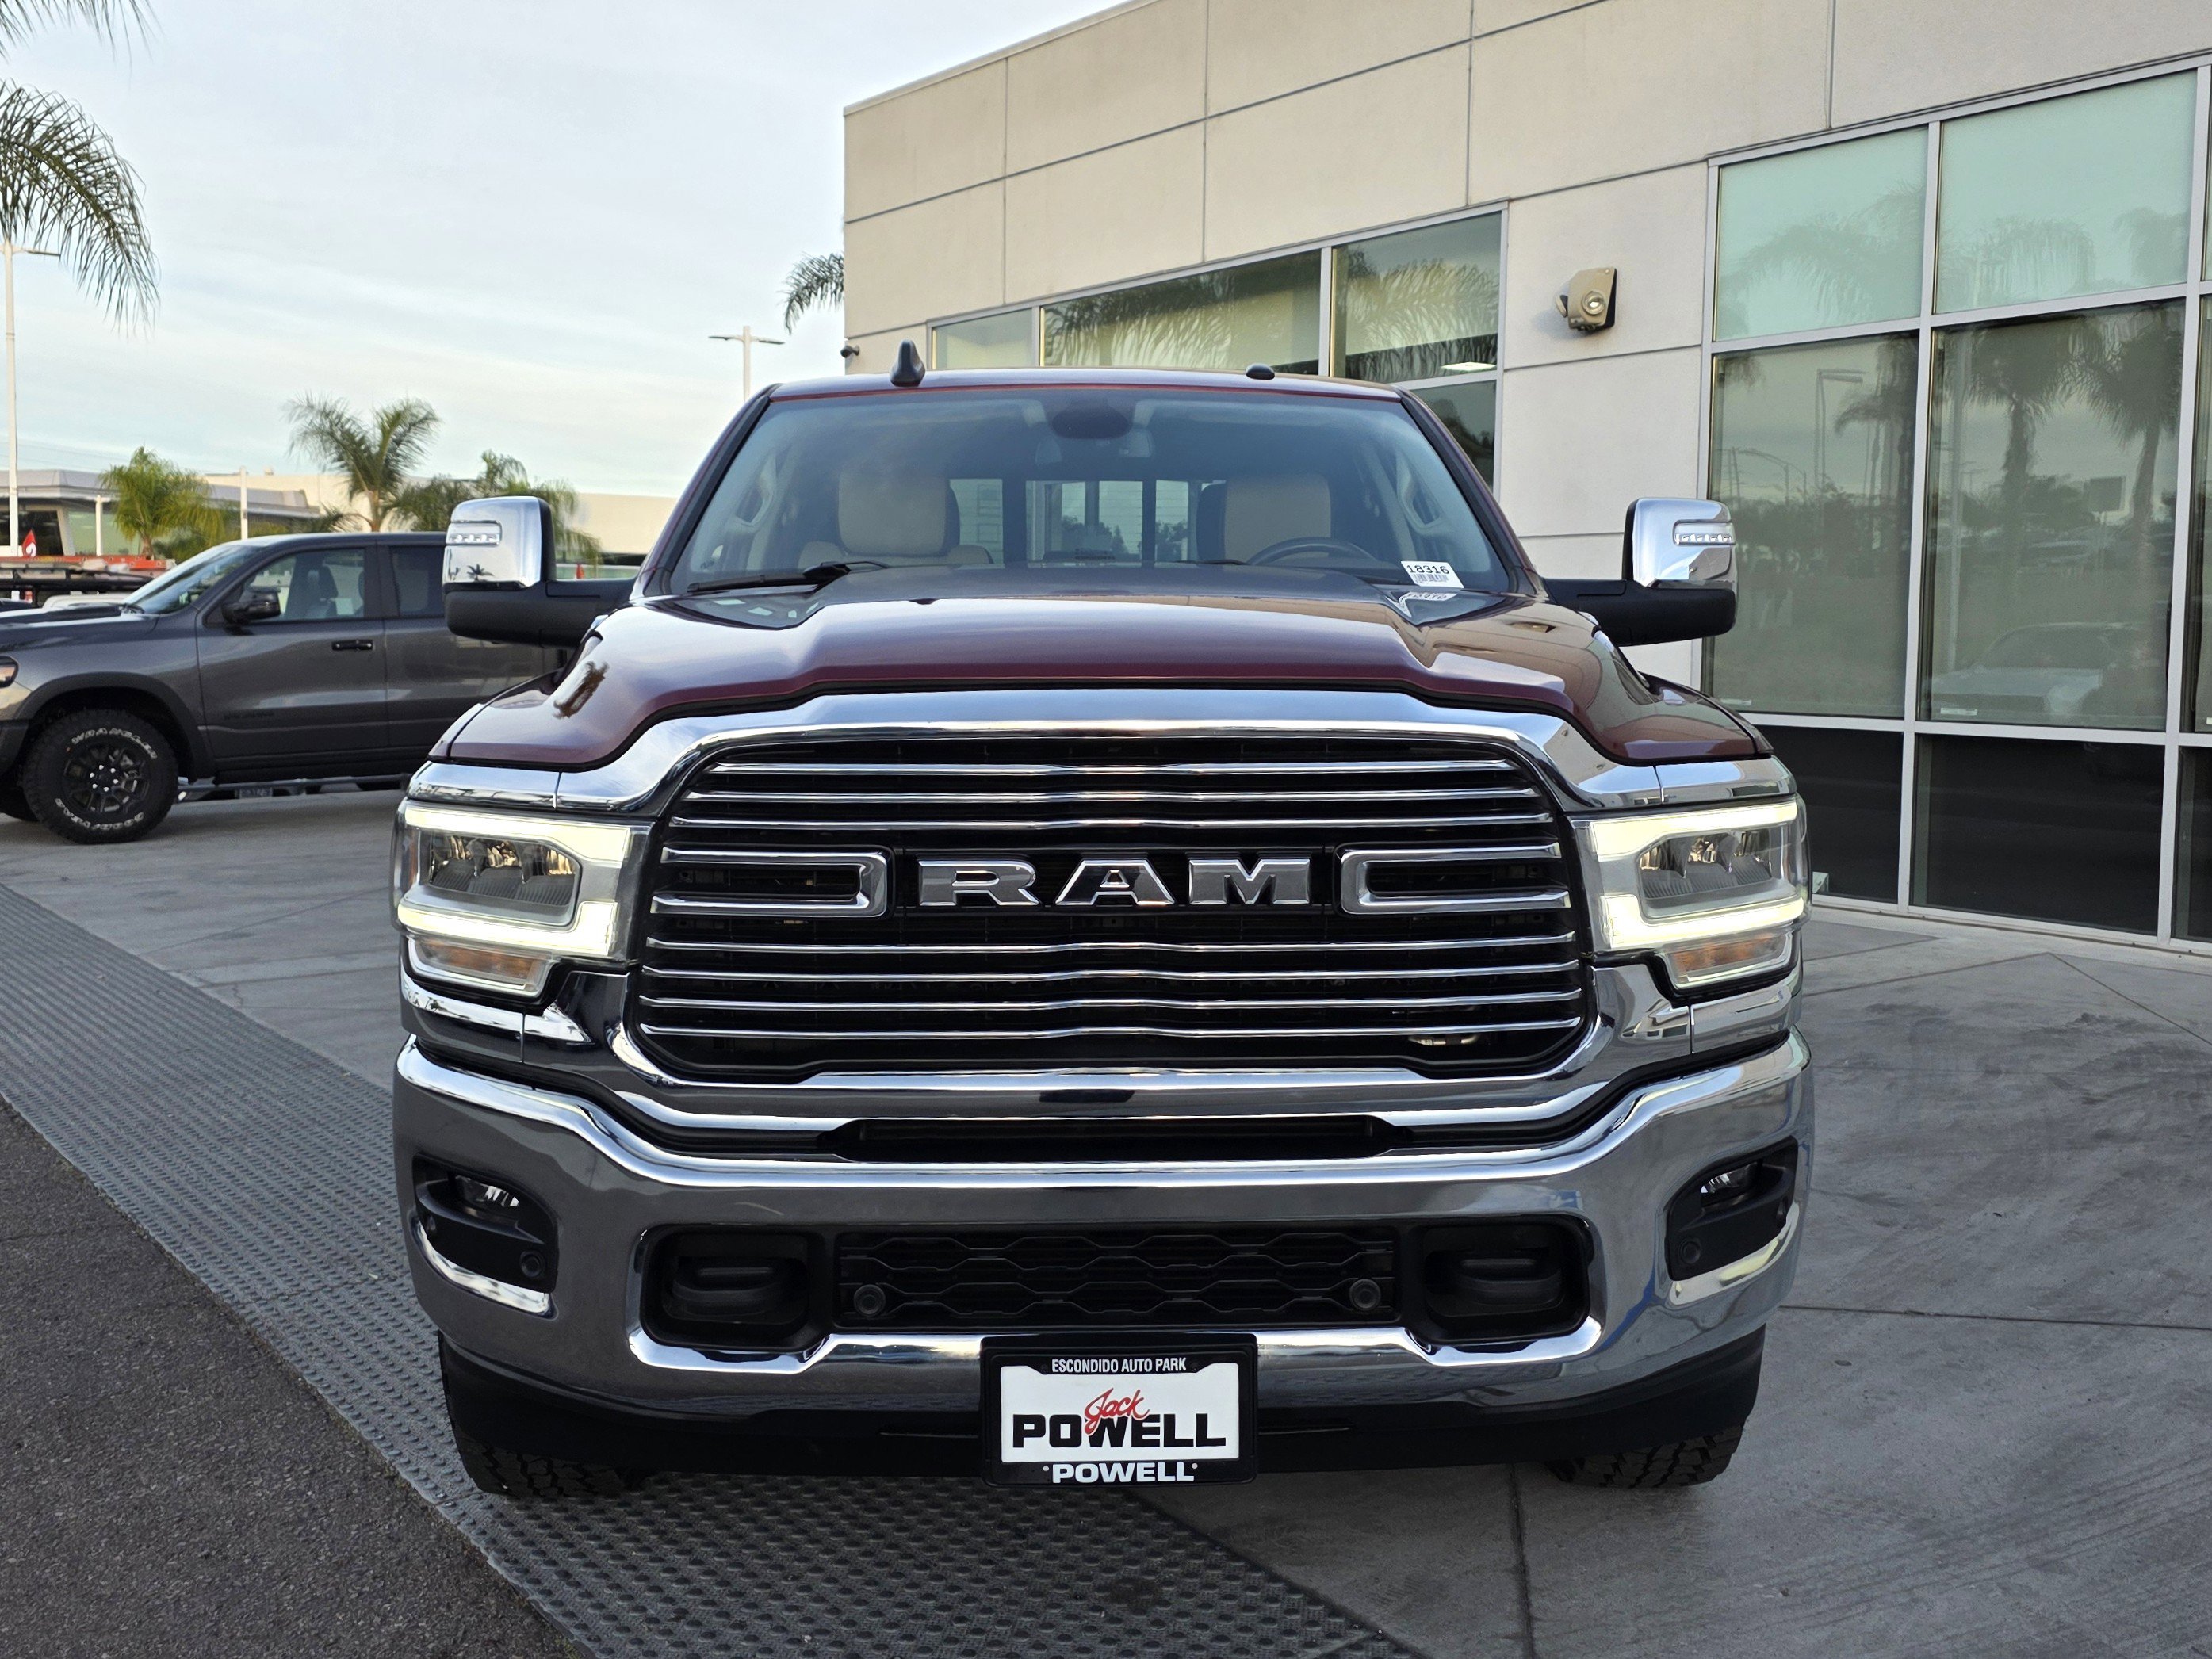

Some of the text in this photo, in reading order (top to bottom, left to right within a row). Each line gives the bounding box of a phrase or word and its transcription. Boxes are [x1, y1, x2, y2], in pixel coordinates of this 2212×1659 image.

[1406, 564, 1450, 575] 18316
[918, 858, 1311, 906] RAM
[1051, 1357, 1187, 1374] ESCONDIDO AUTO PARK
[1084, 1387, 1150, 1436] Jack
[1012, 1413, 1227, 1448] POWELL
[1051, 1462, 1195, 1484] POWELL
